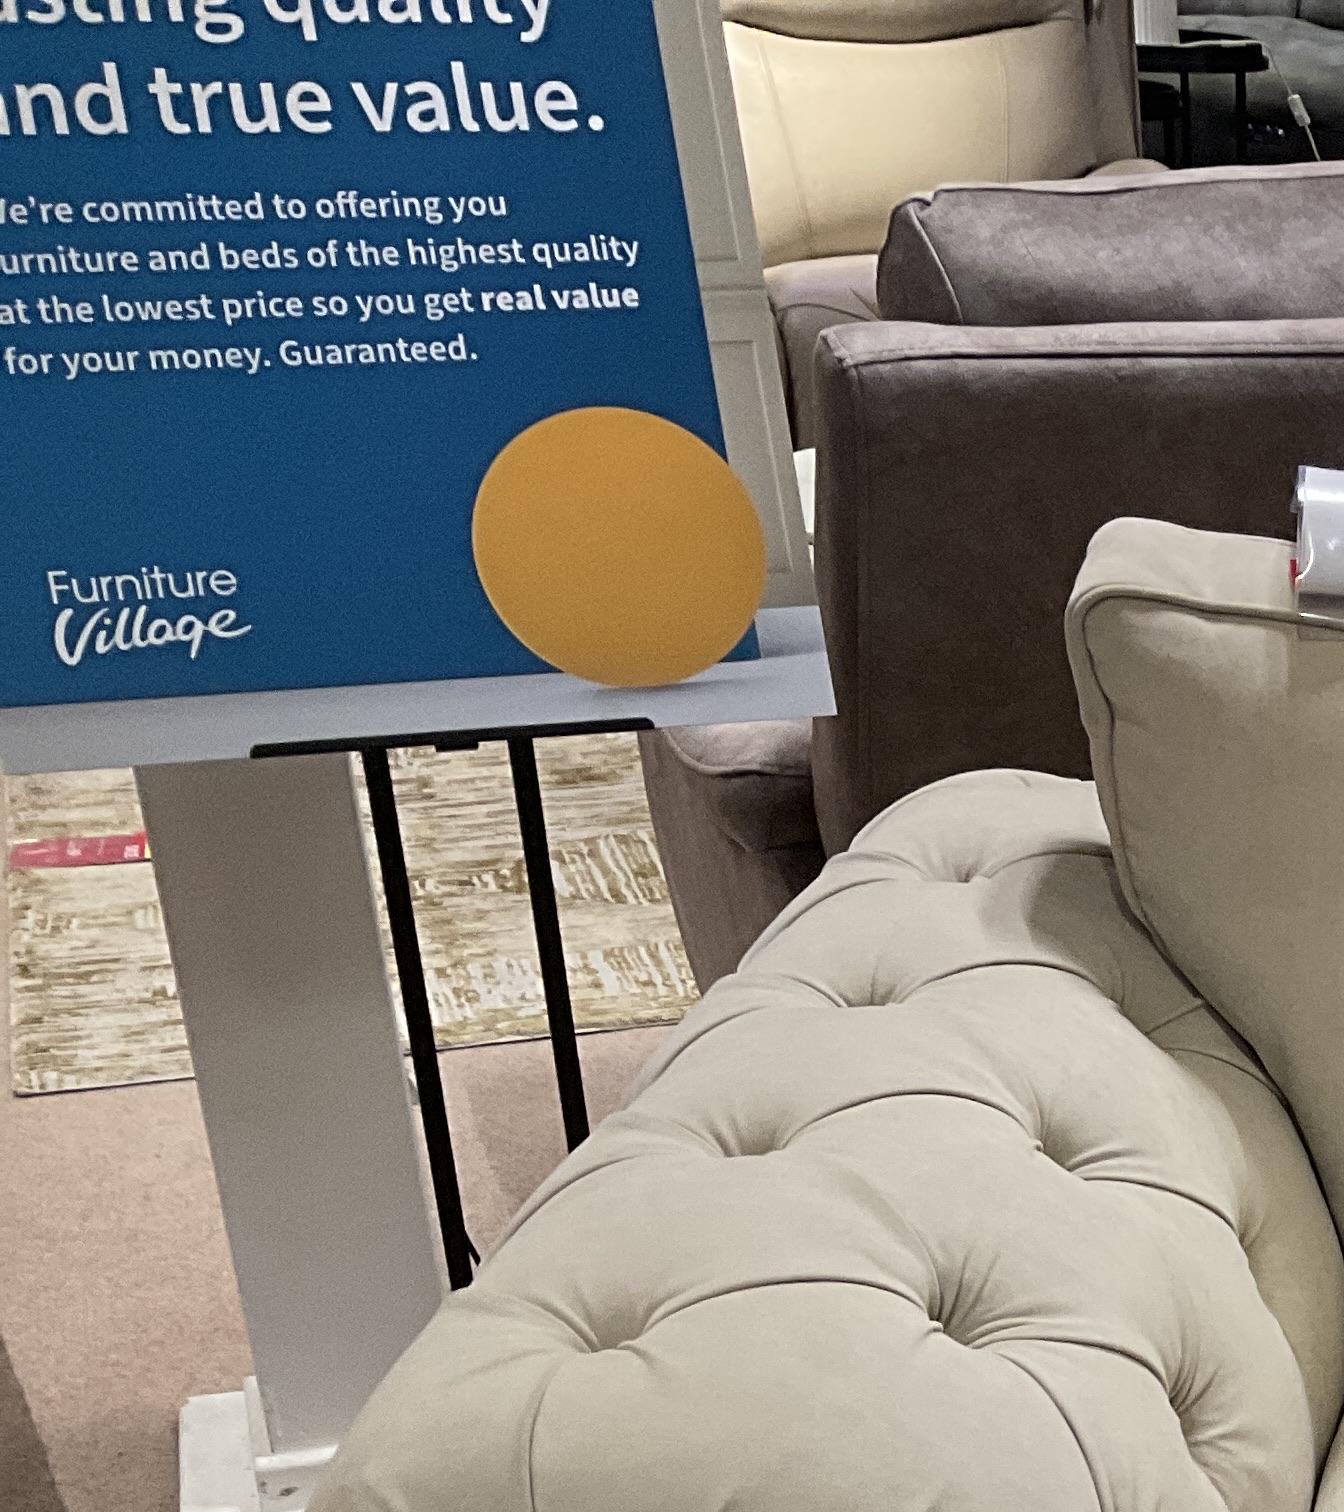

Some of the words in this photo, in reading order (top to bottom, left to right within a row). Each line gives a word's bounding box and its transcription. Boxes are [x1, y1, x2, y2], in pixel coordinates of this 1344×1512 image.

[0, 62, 128, 135] nd
[148, 68, 332, 134] true
[351, 61, 604, 132] value.
[0, 196, 72, 224] e're
[83, 192, 264, 222] committed
[272, 194, 306, 218] to
[316, 191, 443, 224] offering
[448, 196, 506, 223] you
[0, 246, 138, 274] urniture
[149, 242, 209, 270] and
[219, 241, 298, 269] beds
[307, 240, 337, 267] of
[346, 240, 400, 266] the
[407, 238, 525, 272] highest
[533, 235, 638, 268] quality
[0, 299, 30, 324] at
[37, 296, 94, 323] the
[102, 294, 215, 321] lowest
[222, 291, 303, 325] price
[313, 296, 348, 316] so
[355, 295, 415, 322] you
[424, 288, 474, 320] get
[481, 284, 546, 311] real
[551, 282, 639, 309] value
[5, 347, 53, 374] for
[62, 351, 139, 379] your
[149, 348, 270, 374] money.
[280, 334, 477, 366] Guaranteed.
[48, 566, 236, 604] Furniture
[55, 605, 251, 666] Village
